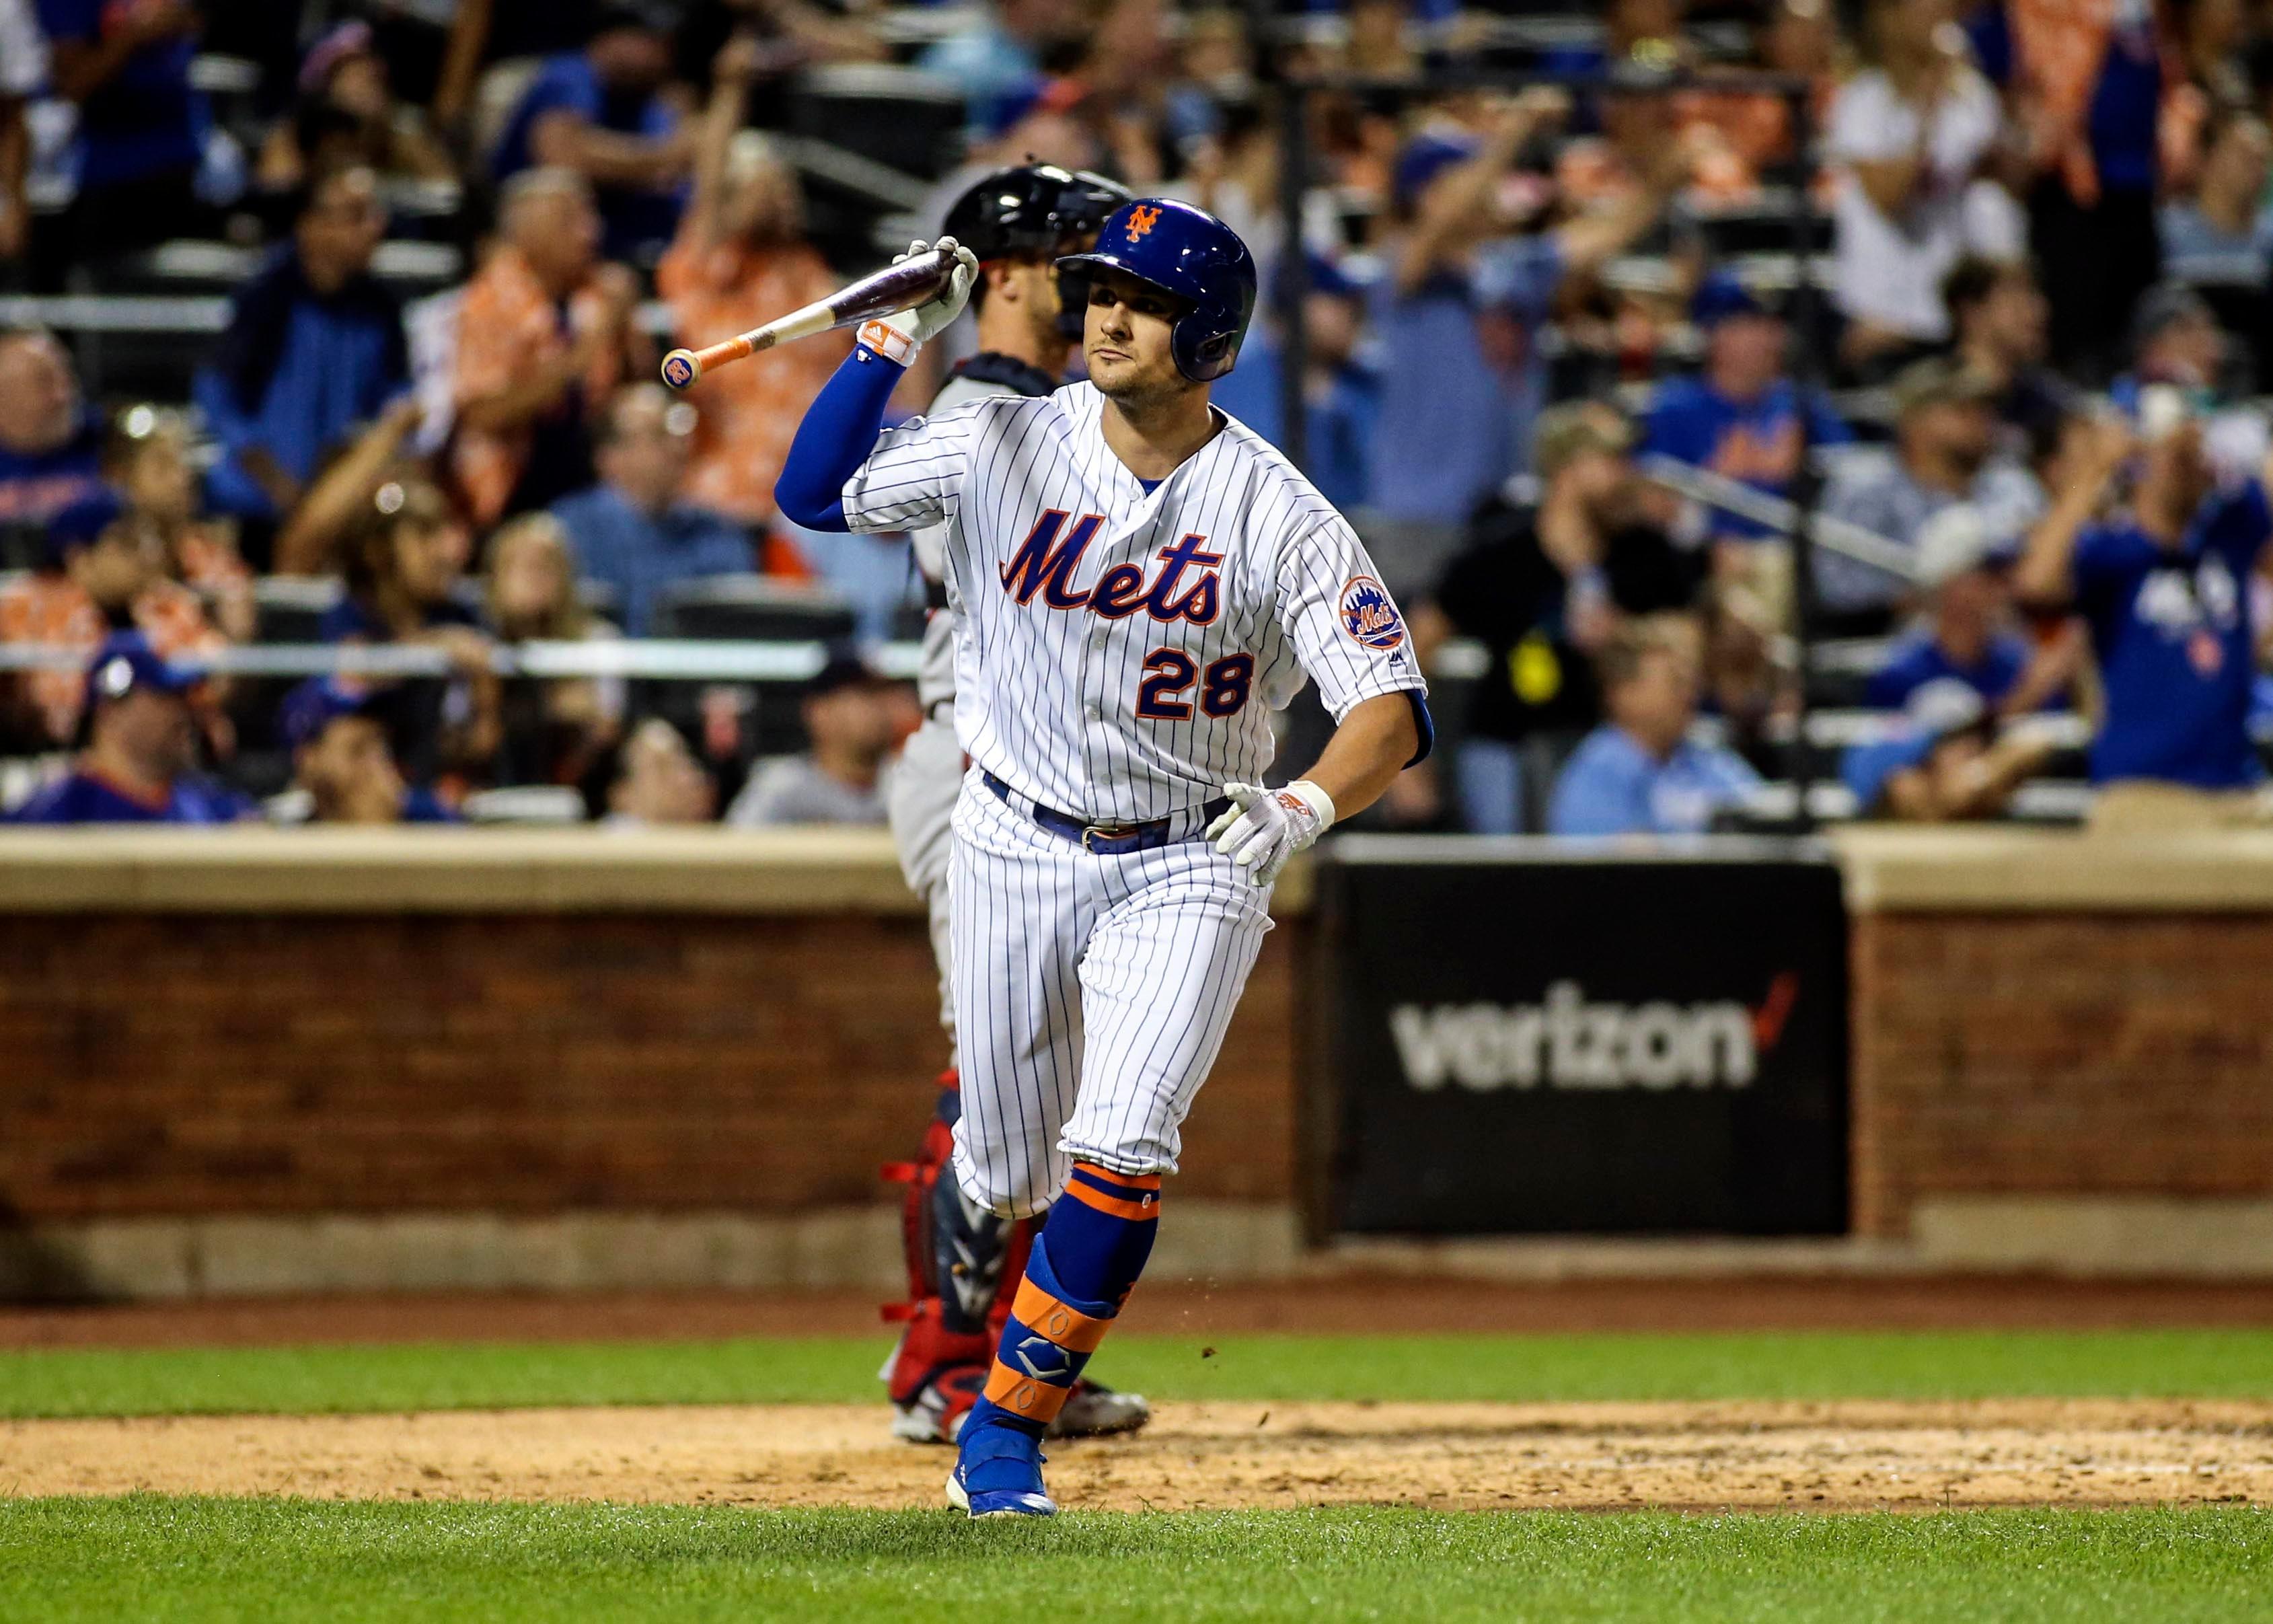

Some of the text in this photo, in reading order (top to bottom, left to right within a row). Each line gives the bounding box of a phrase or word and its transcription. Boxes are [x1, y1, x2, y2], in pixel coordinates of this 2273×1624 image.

[666, 359, 690, 384] 28
[1000, 508, 1225, 626] Mets
[1356, 601, 1394, 634] Mets
[1135, 647, 1255, 721] 28
[1390, 980, 1757, 1089] verizon
